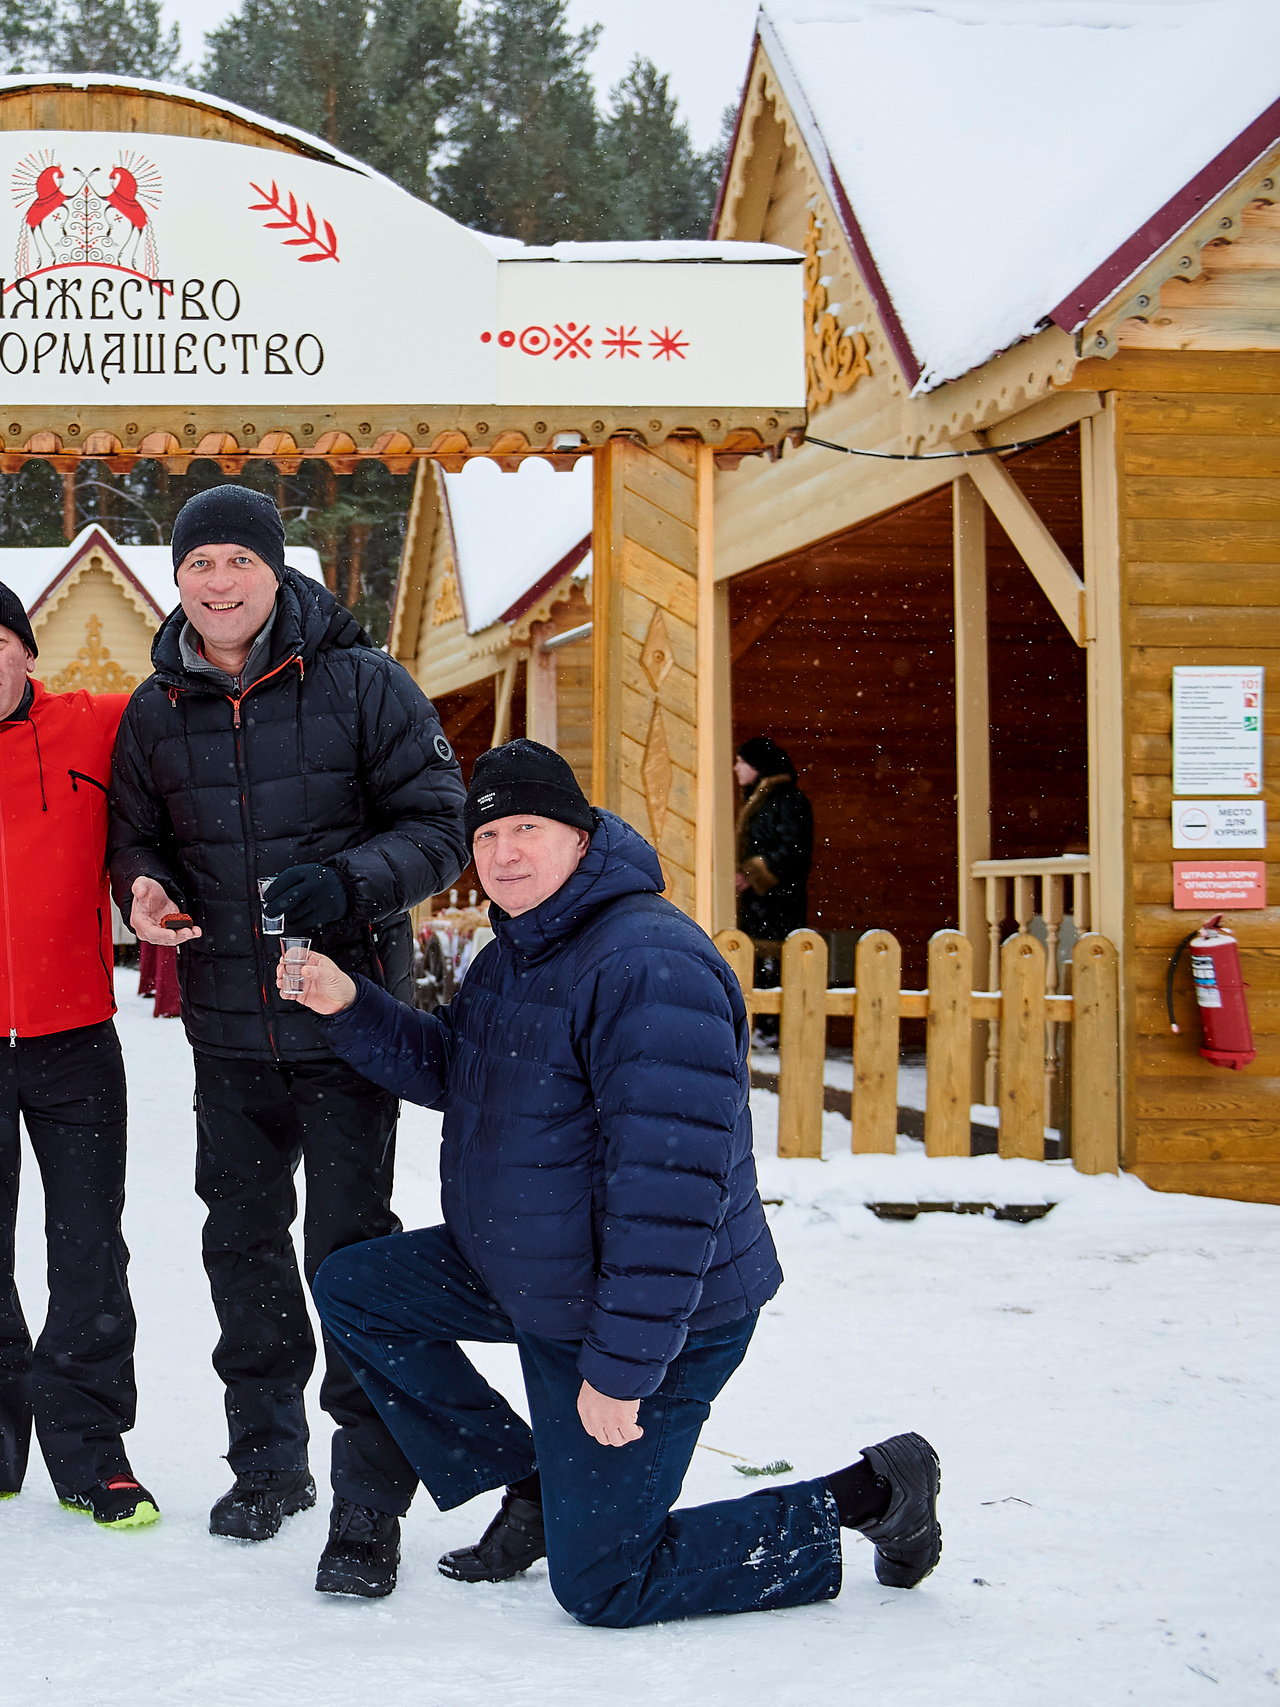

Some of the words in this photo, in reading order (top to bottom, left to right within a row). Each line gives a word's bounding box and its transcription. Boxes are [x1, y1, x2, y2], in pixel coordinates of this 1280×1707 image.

[1241, 680, 1259, 689] 101
[1219, 808, 1252, 816] МЕСТО
[1225, 818, 1246, 826] ДЛЯ
[1214, 828, 1258, 836] КУРЕНИЯ
[1181, 871, 1215, 879] ШТРАФ
[1215, 871, 1227, 879] ЗА
[1228, 871, 1258, 879] ПОРЧУ
[1184, 881, 1255, 889] ОГНЕТУШИТЕЛЯ
[1193, 891, 1215, 899] 5000
[1215, 891, 1247, 900] рублей
